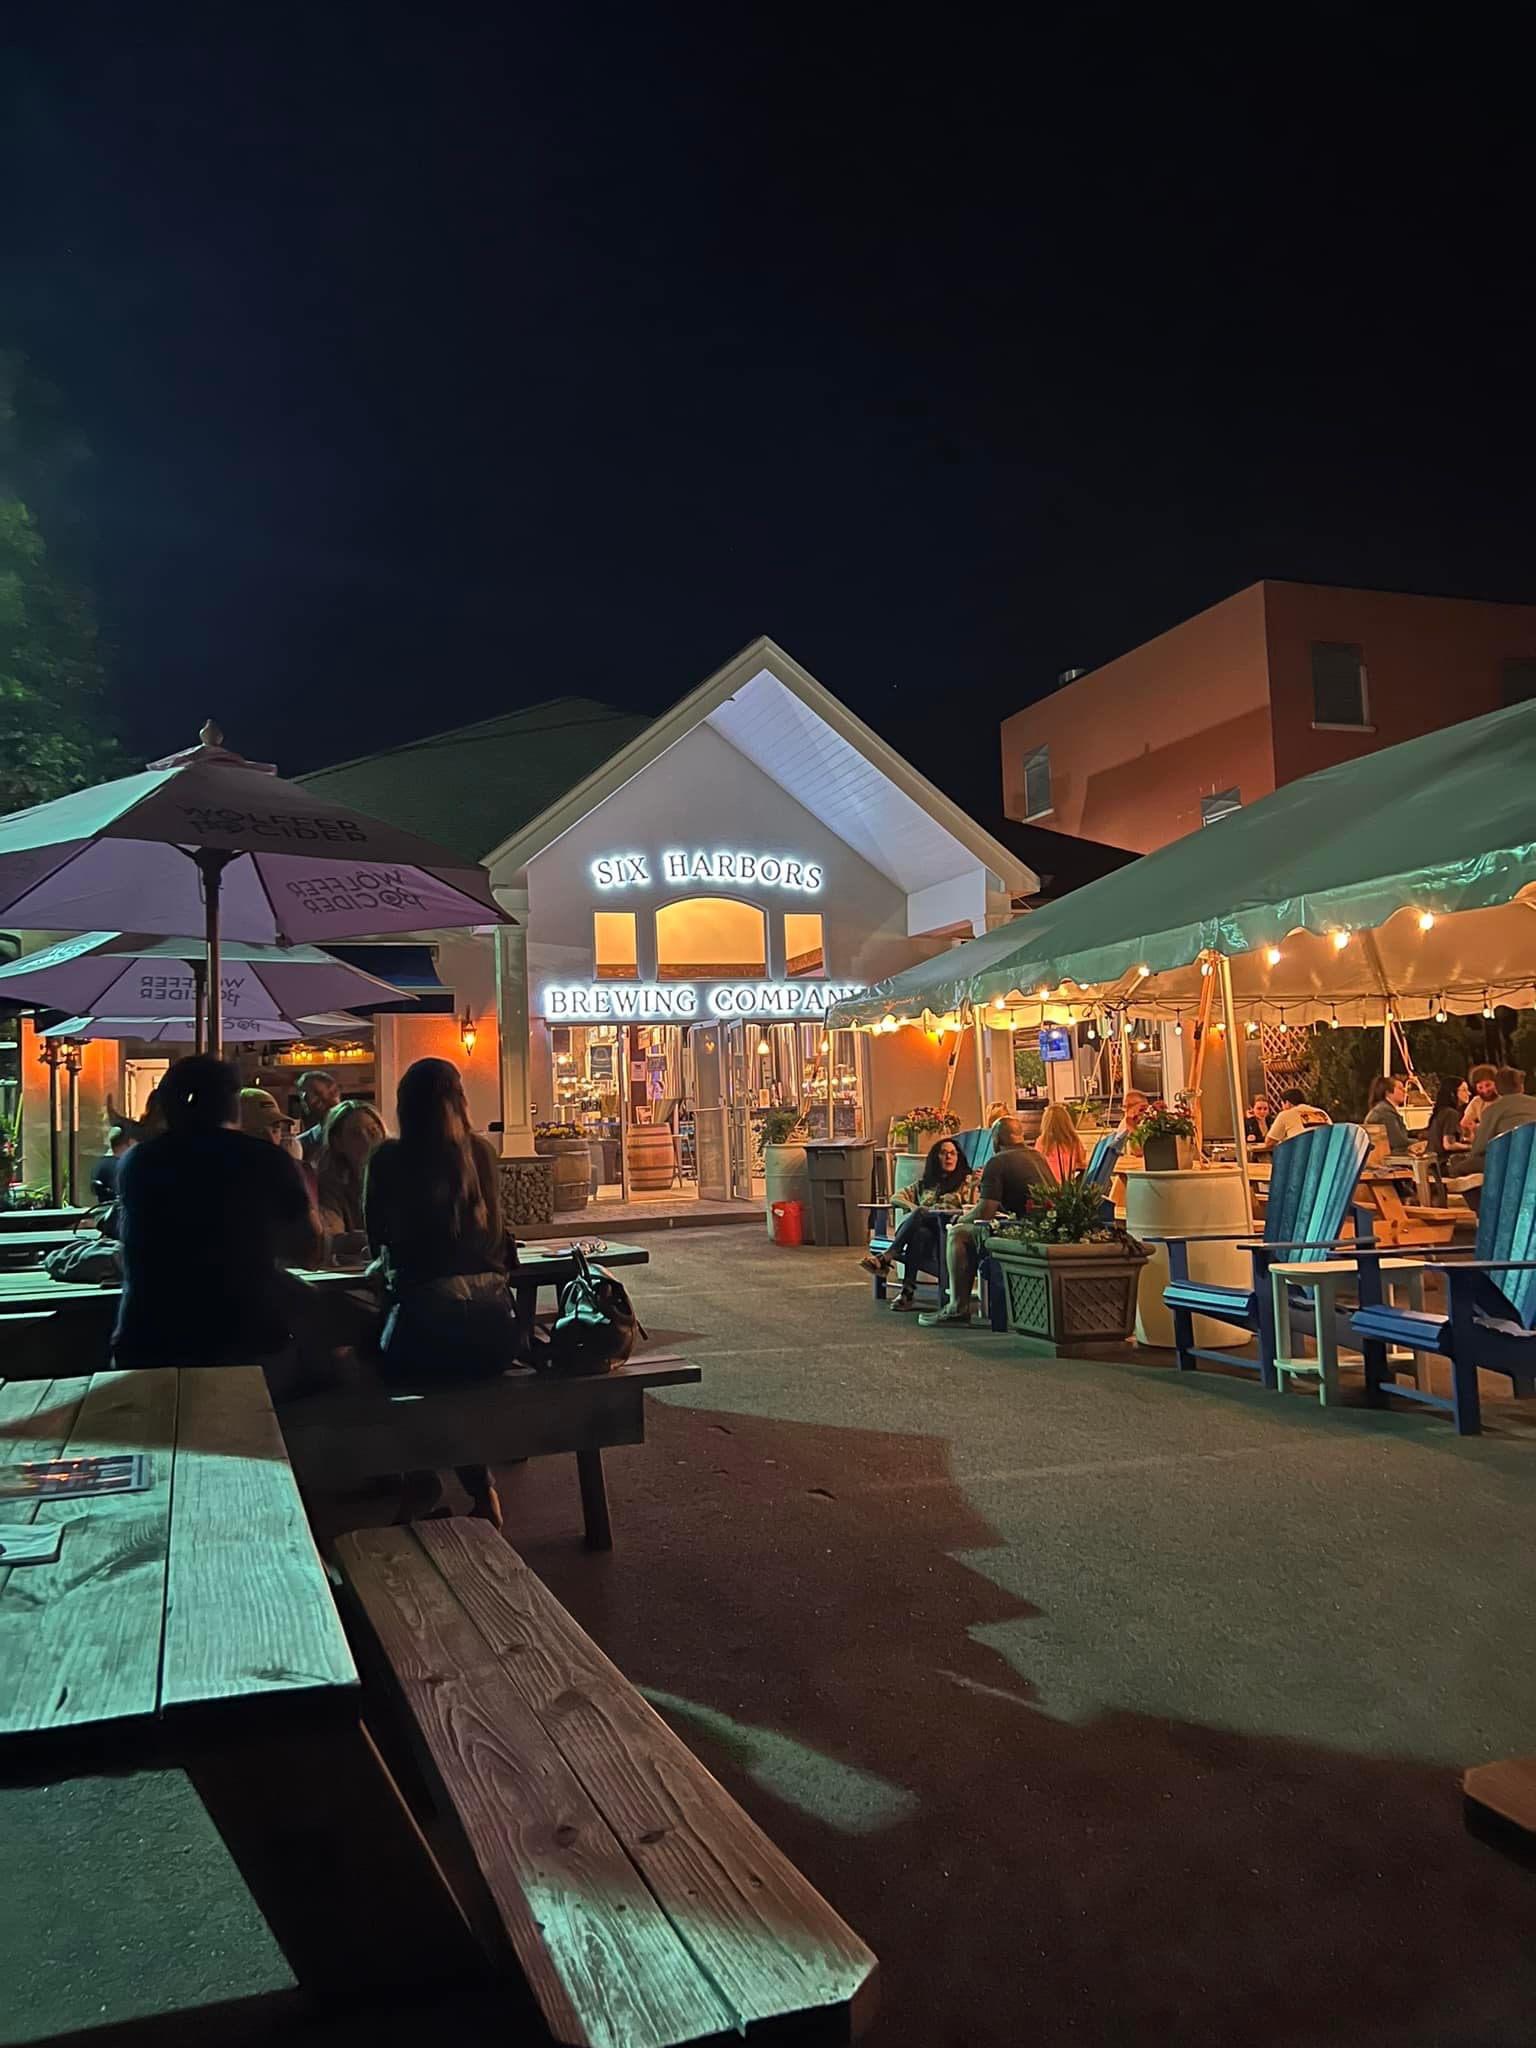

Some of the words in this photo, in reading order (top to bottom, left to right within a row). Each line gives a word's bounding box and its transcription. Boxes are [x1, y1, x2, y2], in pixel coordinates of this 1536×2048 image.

[597, 857, 649, 885] SIX
[668, 853, 822, 889] HARBORS
[550, 989, 697, 1013] BREWING
